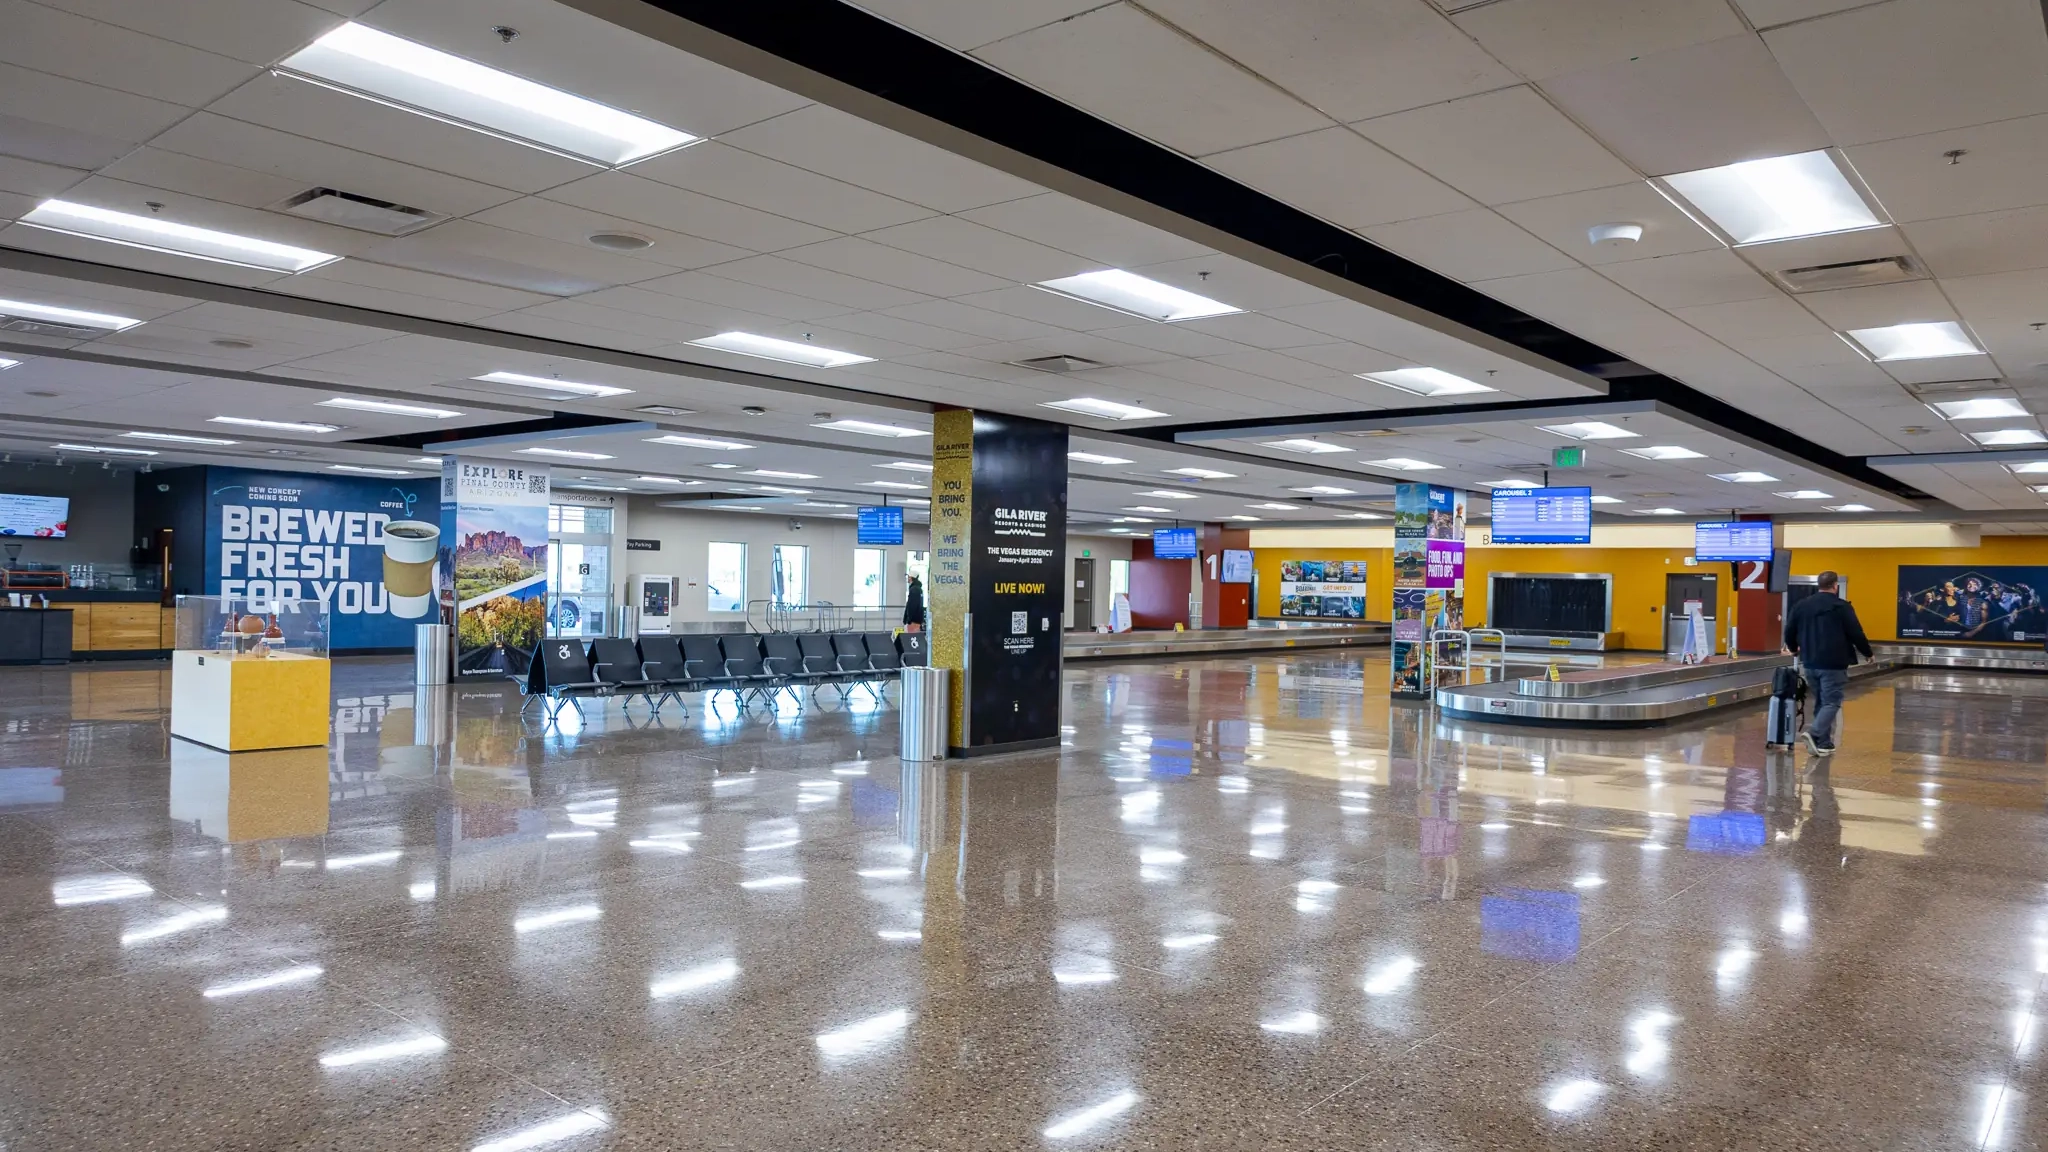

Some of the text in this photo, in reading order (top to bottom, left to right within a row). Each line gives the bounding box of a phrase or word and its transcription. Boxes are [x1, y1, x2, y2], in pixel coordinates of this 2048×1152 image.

[461, 478, 526, 490] PINAL COUNTY
[943, 480, 961, 490] YOU
[249, 486, 301, 496] NEW CONCEPT
[469, 488, 518, 498] ARIZONA
[249, 493, 298, 502] COMING SOON
[939, 494, 965, 504] BRING
[380, 501, 404, 509] COFFEE
[941, 507, 961, 517] YOU.
[995, 508, 1017, 519] GILA
[222, 504, 391, 545] BREWED
[943, 534, 957, 544] WE
[635, 541, 652, 549] Parking
[937, 548, 963, 557] BRING
[987, 546, 1053, 557] THE VEGAS RESIDENCY
[221, 542, 350, 579] FRESH
[998, 556, 1030, 564] January-April
[1453, 551, 1463, 565] AND
[581, 566, 588, 575] G
[942, 561, 959, 570] THE
[1206, 554, 1217, 580] 1
[1428, 564, 1454, 578] PHOTO OPS
[1740, 560, 1765, 589] 2
[934, 575, 965, 585] VEGAS.
[995, 583, 1045, 594] LIVE NOW!
[220, 579, 389, 615] FOR YOU
[1003, 636, 1035, 645] SCAN HERE
